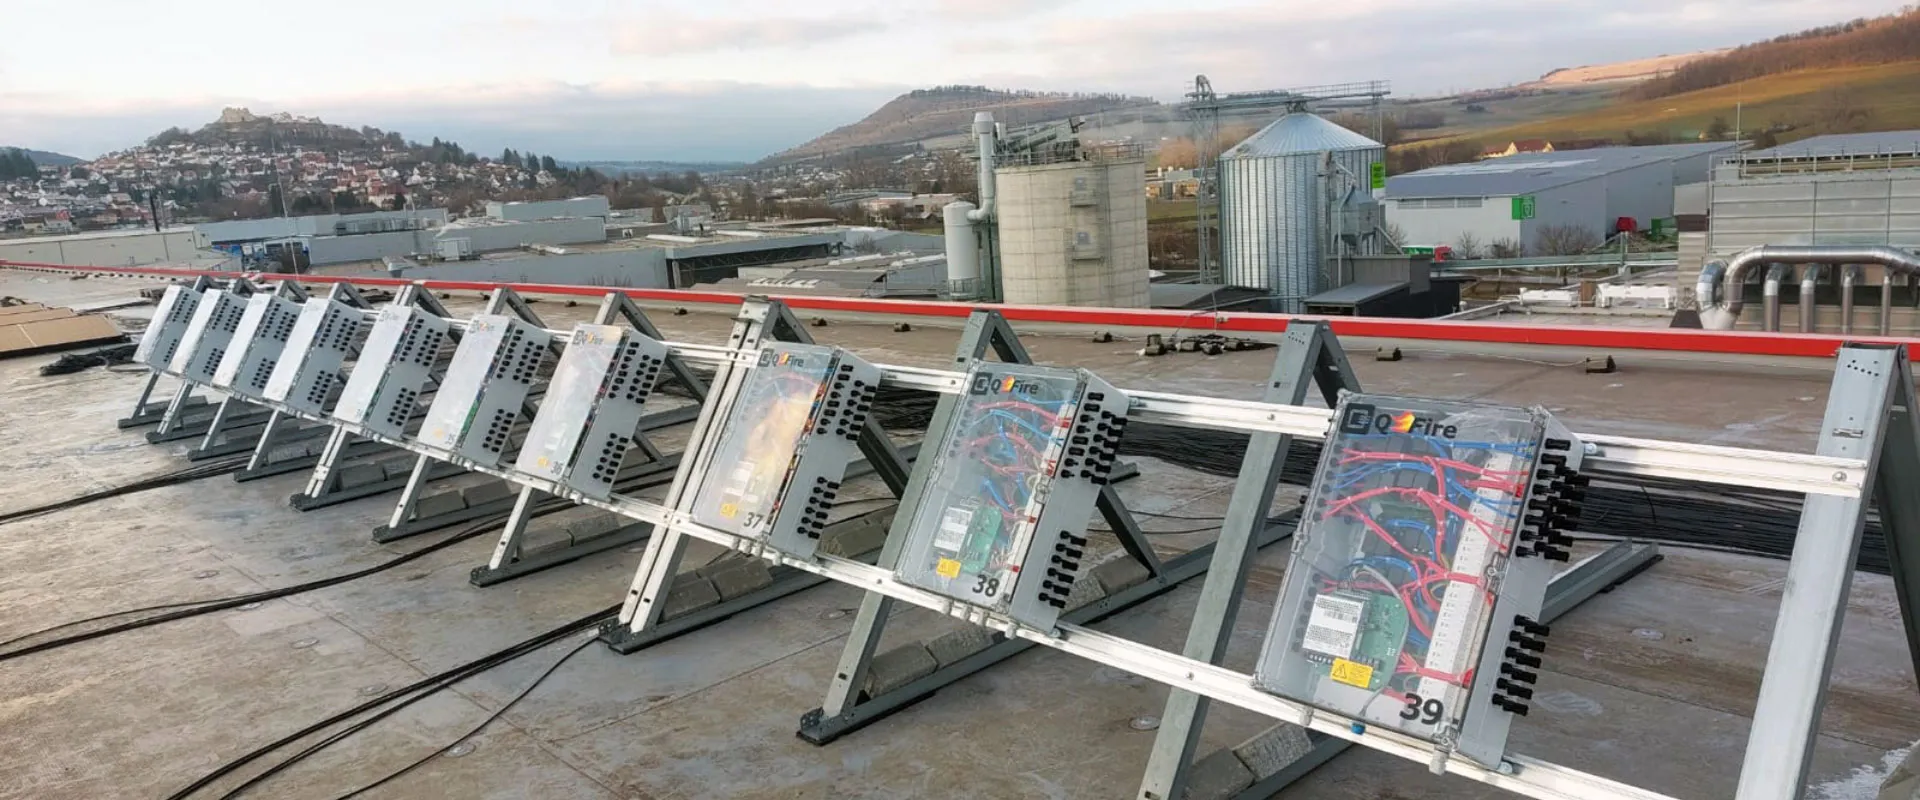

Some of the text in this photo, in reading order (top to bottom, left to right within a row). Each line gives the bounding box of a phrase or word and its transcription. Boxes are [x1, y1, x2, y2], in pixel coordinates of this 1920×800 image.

[991, 378, 1038, 394] Q Fire
[1375, 413, 1458, 438] Q Fire
[743, 512, 764, 529] 37
[972, 574, 1000, 597] 38
[1399, 692, 1444, 725] 39
